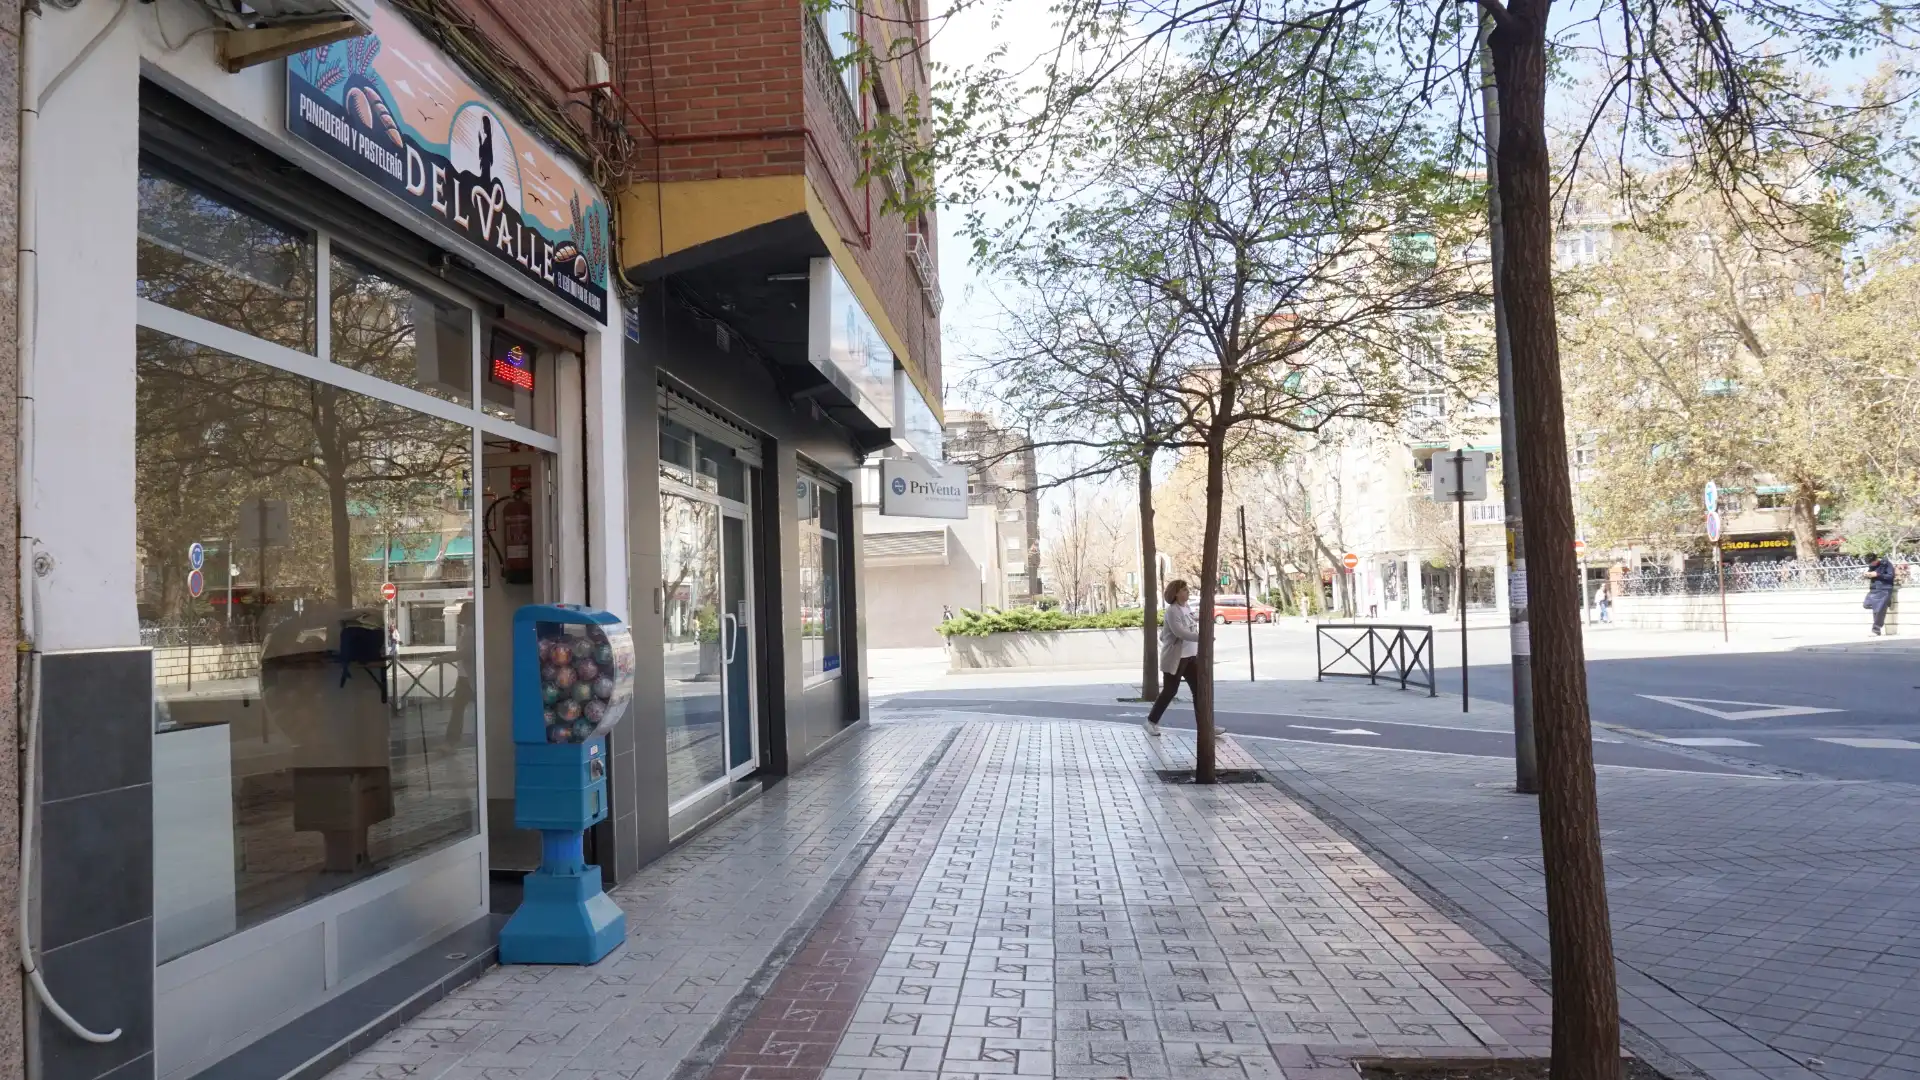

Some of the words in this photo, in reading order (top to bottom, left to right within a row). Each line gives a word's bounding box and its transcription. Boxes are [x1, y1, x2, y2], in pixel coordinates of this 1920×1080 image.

[300, 93, 350, 147] PANADERÍA
[351, 127, 358, 151] Y
[359, 134, 403, 182] PASTELERÍA
[405, 143, 469, 231] DEL
[471, 182, 555, 286] VALLE
[910, 480, 961, 496] PriVenta
[1759, 540, 1789, 548] JUEGO
